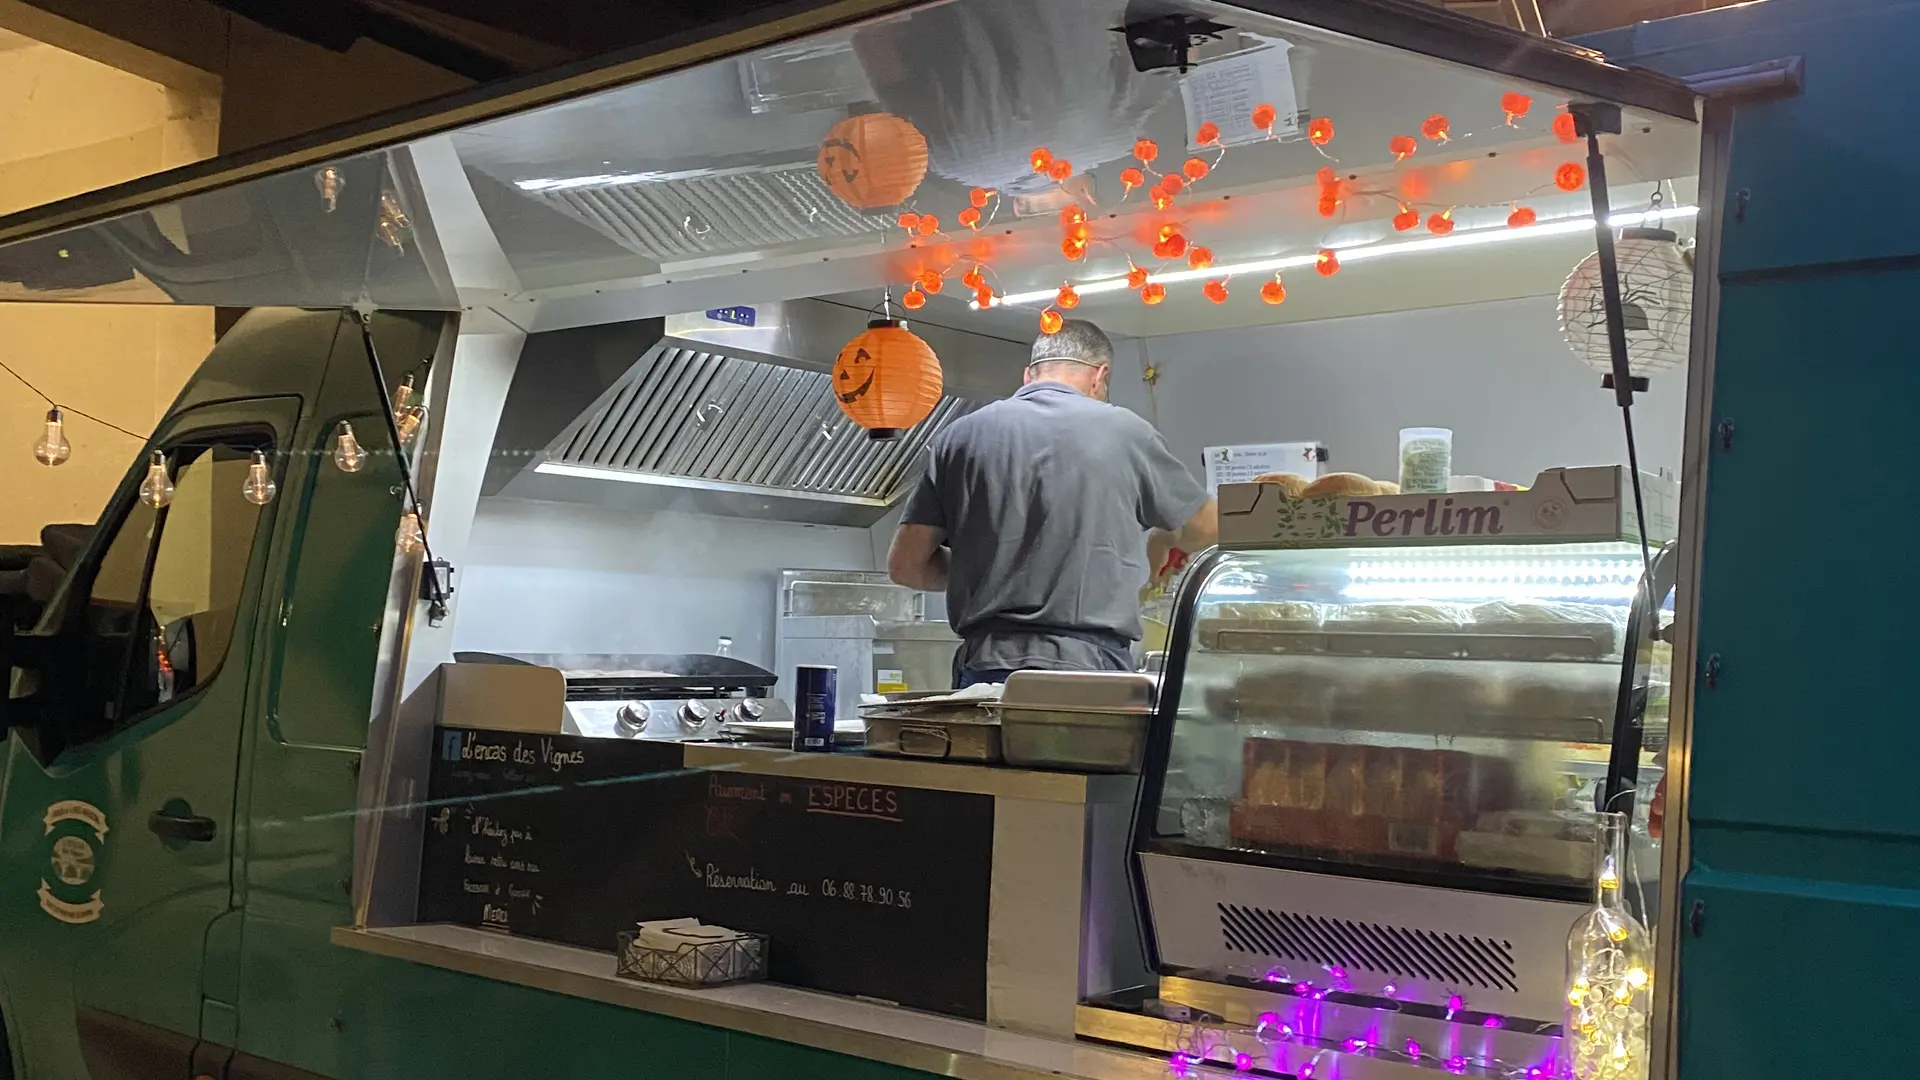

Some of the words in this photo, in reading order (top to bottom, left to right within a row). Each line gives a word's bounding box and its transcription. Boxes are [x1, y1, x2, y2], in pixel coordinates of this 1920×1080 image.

[1343, 498, 1503, 537] Perlim
[513, 740, 536, 765] des
[541, 737, 584, 772] Vignes
[706, 863, 777, 892] Réservation
[786, 882, 809, 896] au
